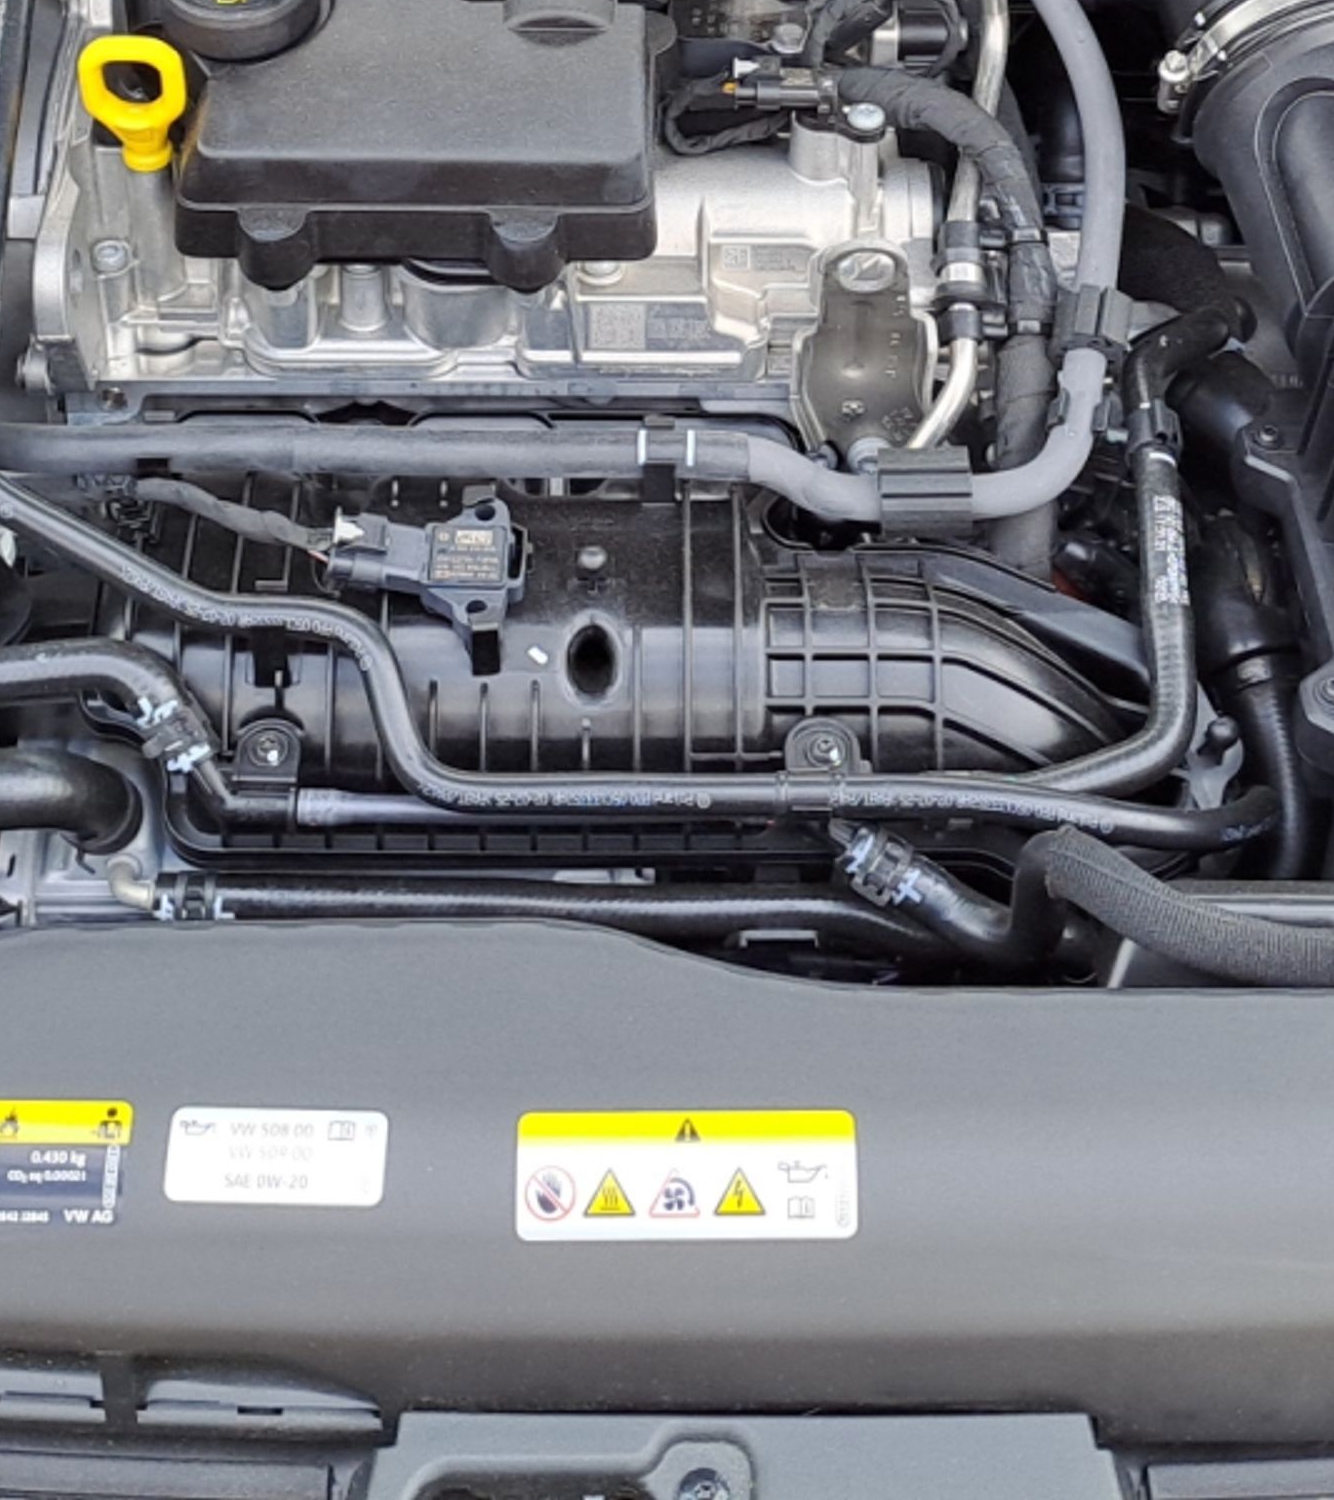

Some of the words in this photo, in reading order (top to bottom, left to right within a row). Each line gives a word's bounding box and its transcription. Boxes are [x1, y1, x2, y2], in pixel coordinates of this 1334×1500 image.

[230, 1122, 256, 1137] VW
[293, 1122, 315, 1138] 00
[70, 1149, 87, 1169] kg
[224, 1172, 250, 1189] SAE
[256, 1172, 308, 1190] 0W-20
[62, 1208, 90, 1223] VW
[91, 1208, 114, 1223] AG
